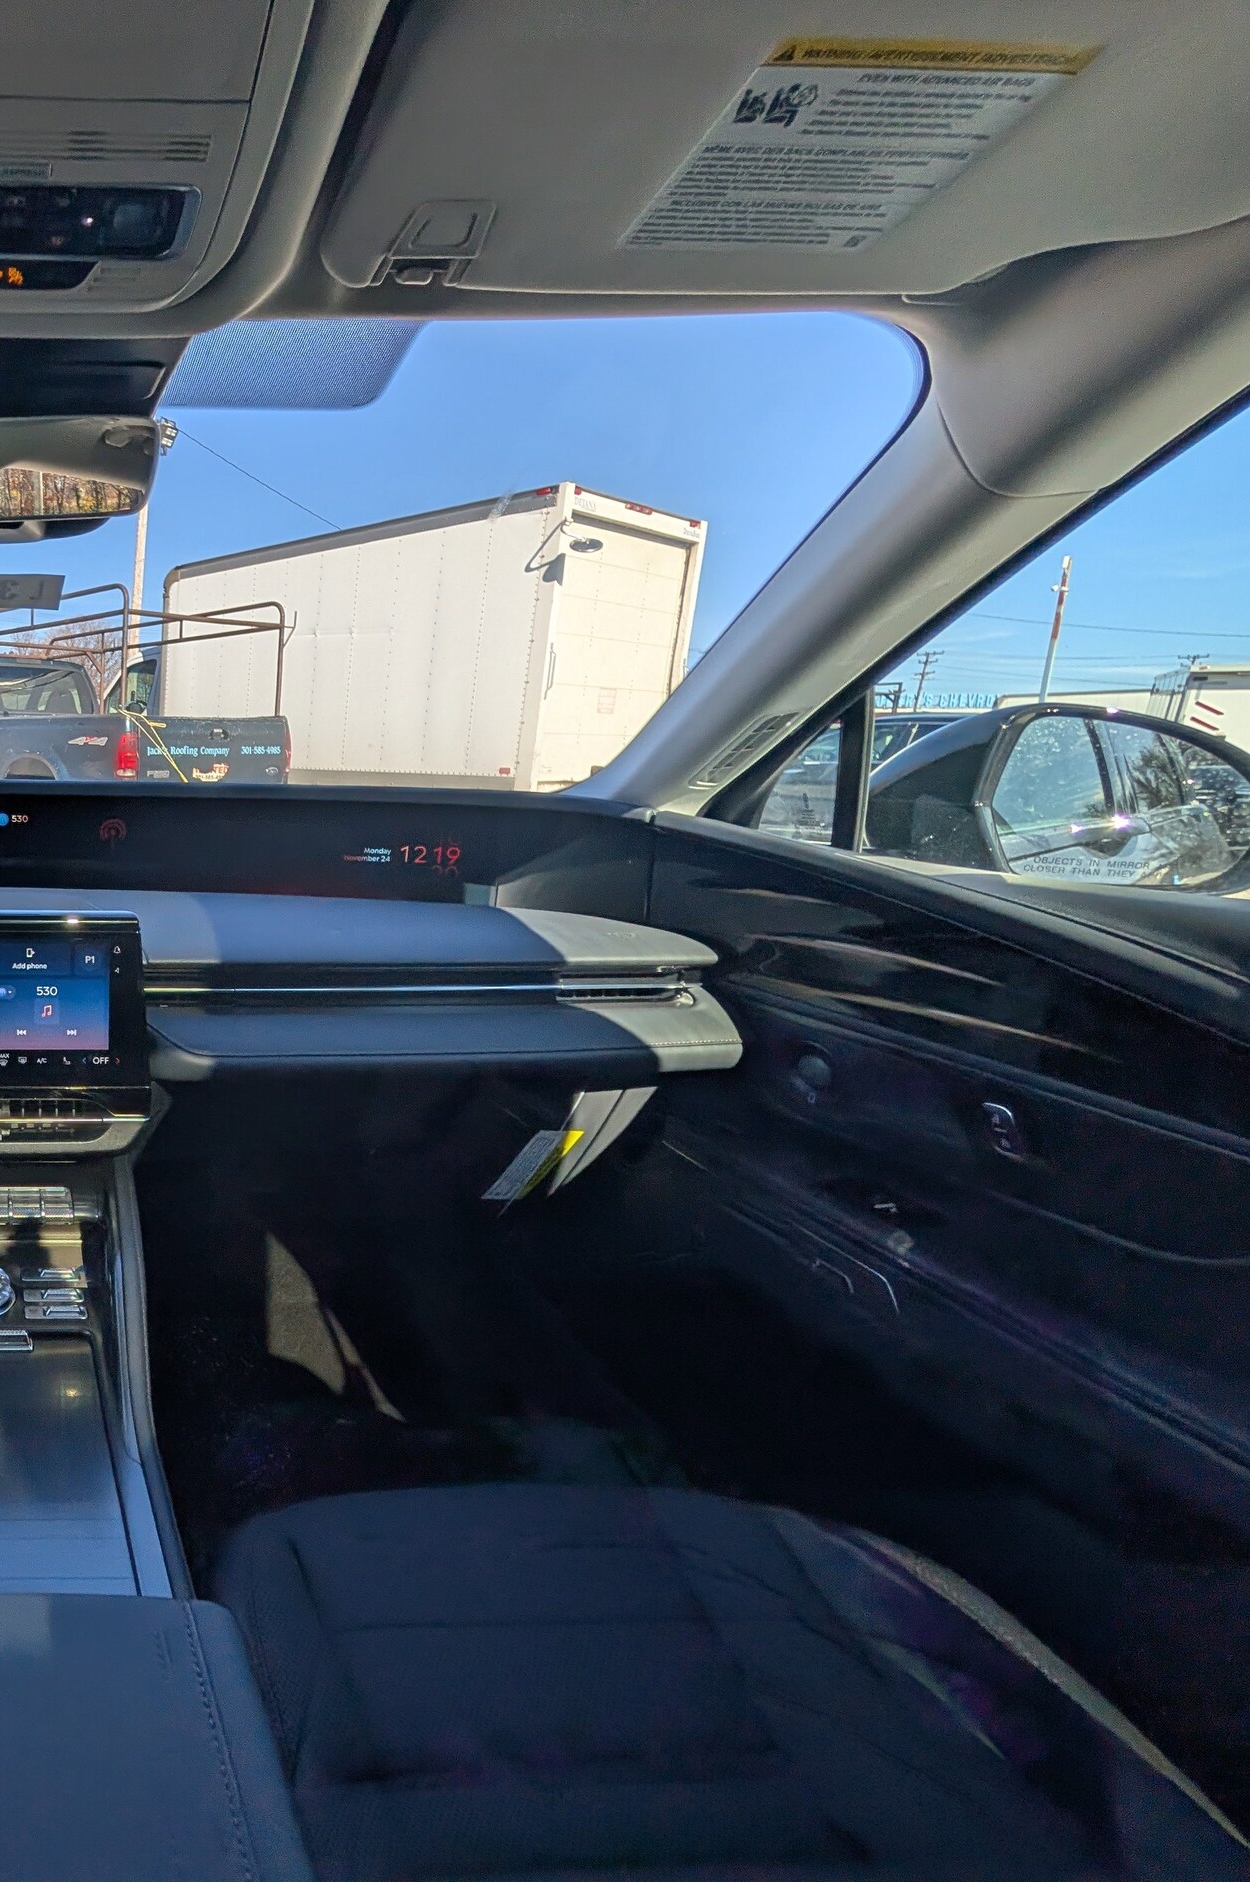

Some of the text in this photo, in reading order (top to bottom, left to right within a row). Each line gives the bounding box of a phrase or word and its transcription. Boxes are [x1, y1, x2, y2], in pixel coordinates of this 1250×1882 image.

[170, 745, 198, 757] Roofing
[200, 746, 230, 757] Company
[11, 814, 28, 823] 530
[363, 847, 391, 855] Monday
[343, 854, 380, 862] November
[1033, 856, 1082, 866] OBJECTS
[1107, 861, 1150, 869] MIRROR
[1023, 864, 1065, 874] CLOSER
[1068, 867, 1100, 876] THAN
[1107, 869, 1136, 878] THEY
[85, 956, 95, 964] P1
[12, 962, 48, 971] Add phone
[36, 986, 58, 996] 530
[92, 1057, 110, 1065] OFF
